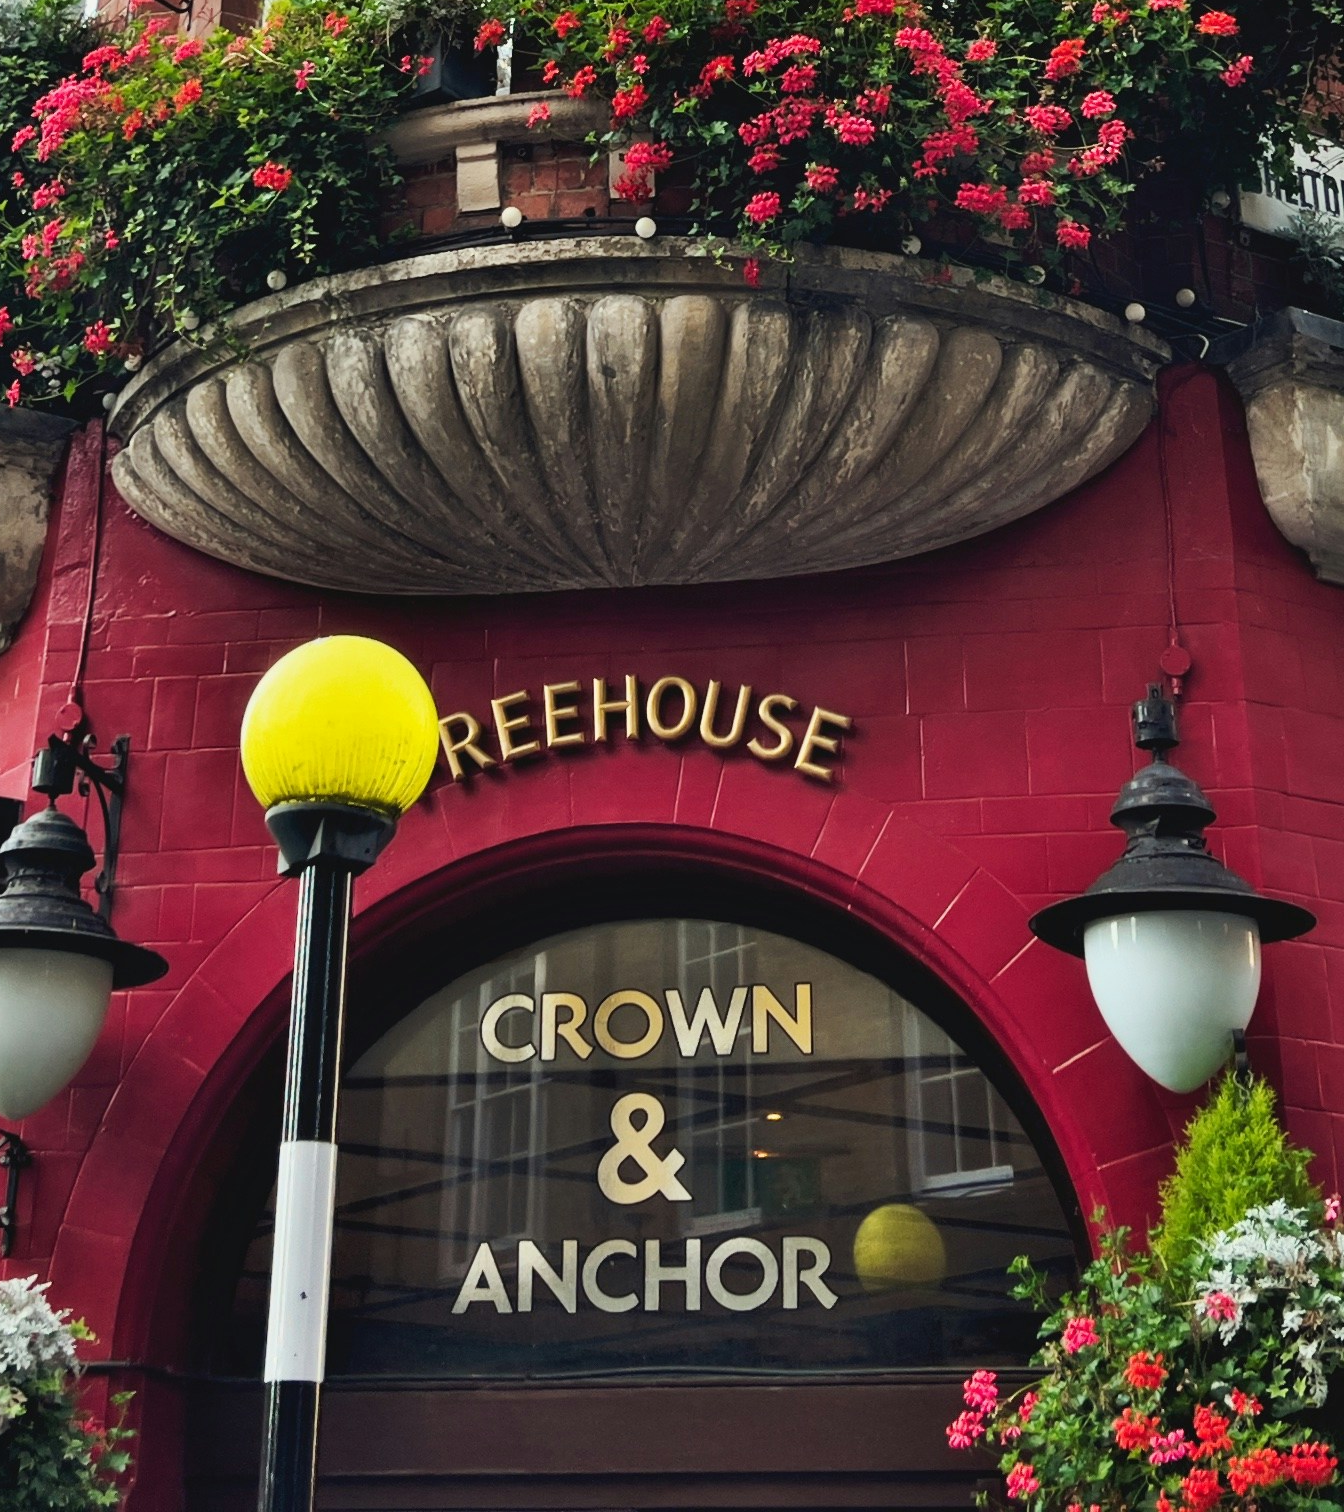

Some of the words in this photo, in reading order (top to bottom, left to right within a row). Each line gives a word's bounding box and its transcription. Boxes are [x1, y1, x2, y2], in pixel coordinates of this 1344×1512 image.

[438, 674, 852, 783] REEHOUSE
[480, 982, 814, 1062] CROWN
[596, 1092, 693, 1205] &
[451, 1236, 839, 1315] ANCHOR
